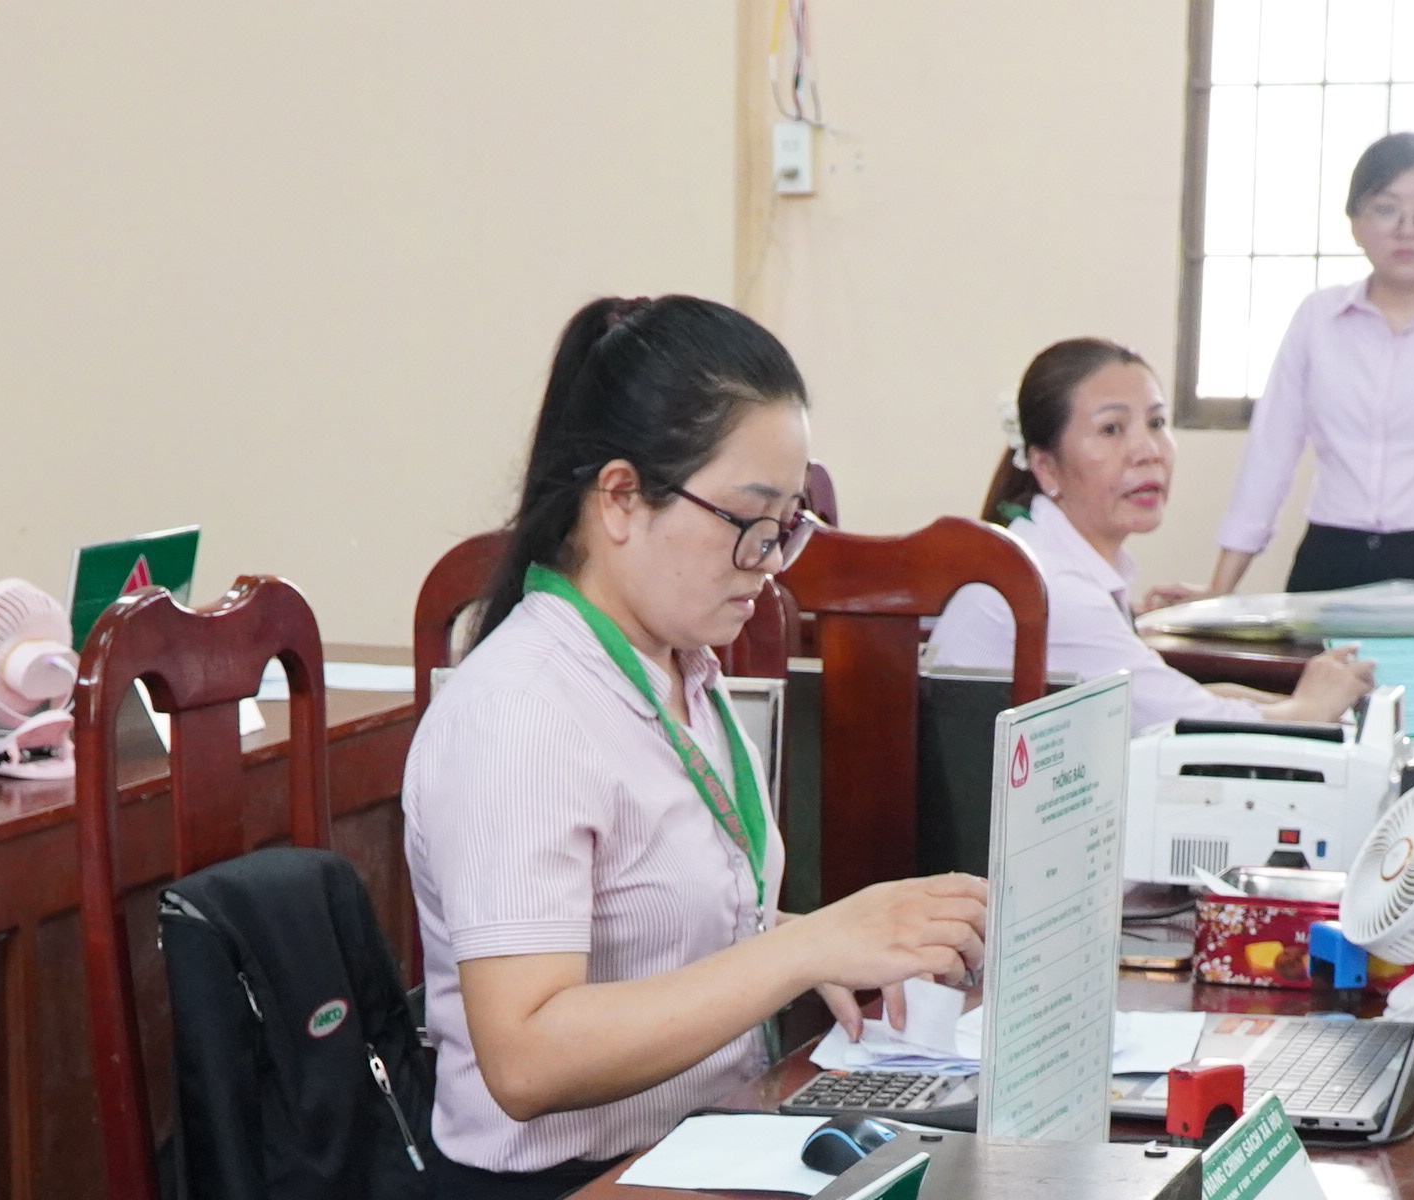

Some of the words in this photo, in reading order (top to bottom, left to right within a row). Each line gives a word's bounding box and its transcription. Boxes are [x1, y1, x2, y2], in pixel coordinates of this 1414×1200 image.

[1221, 1144, 1247, 1178] CHÍNH
[1241, 1128, 1264, 1158] SÁCH
[1237, 1174, 1252, 1193] FOR
